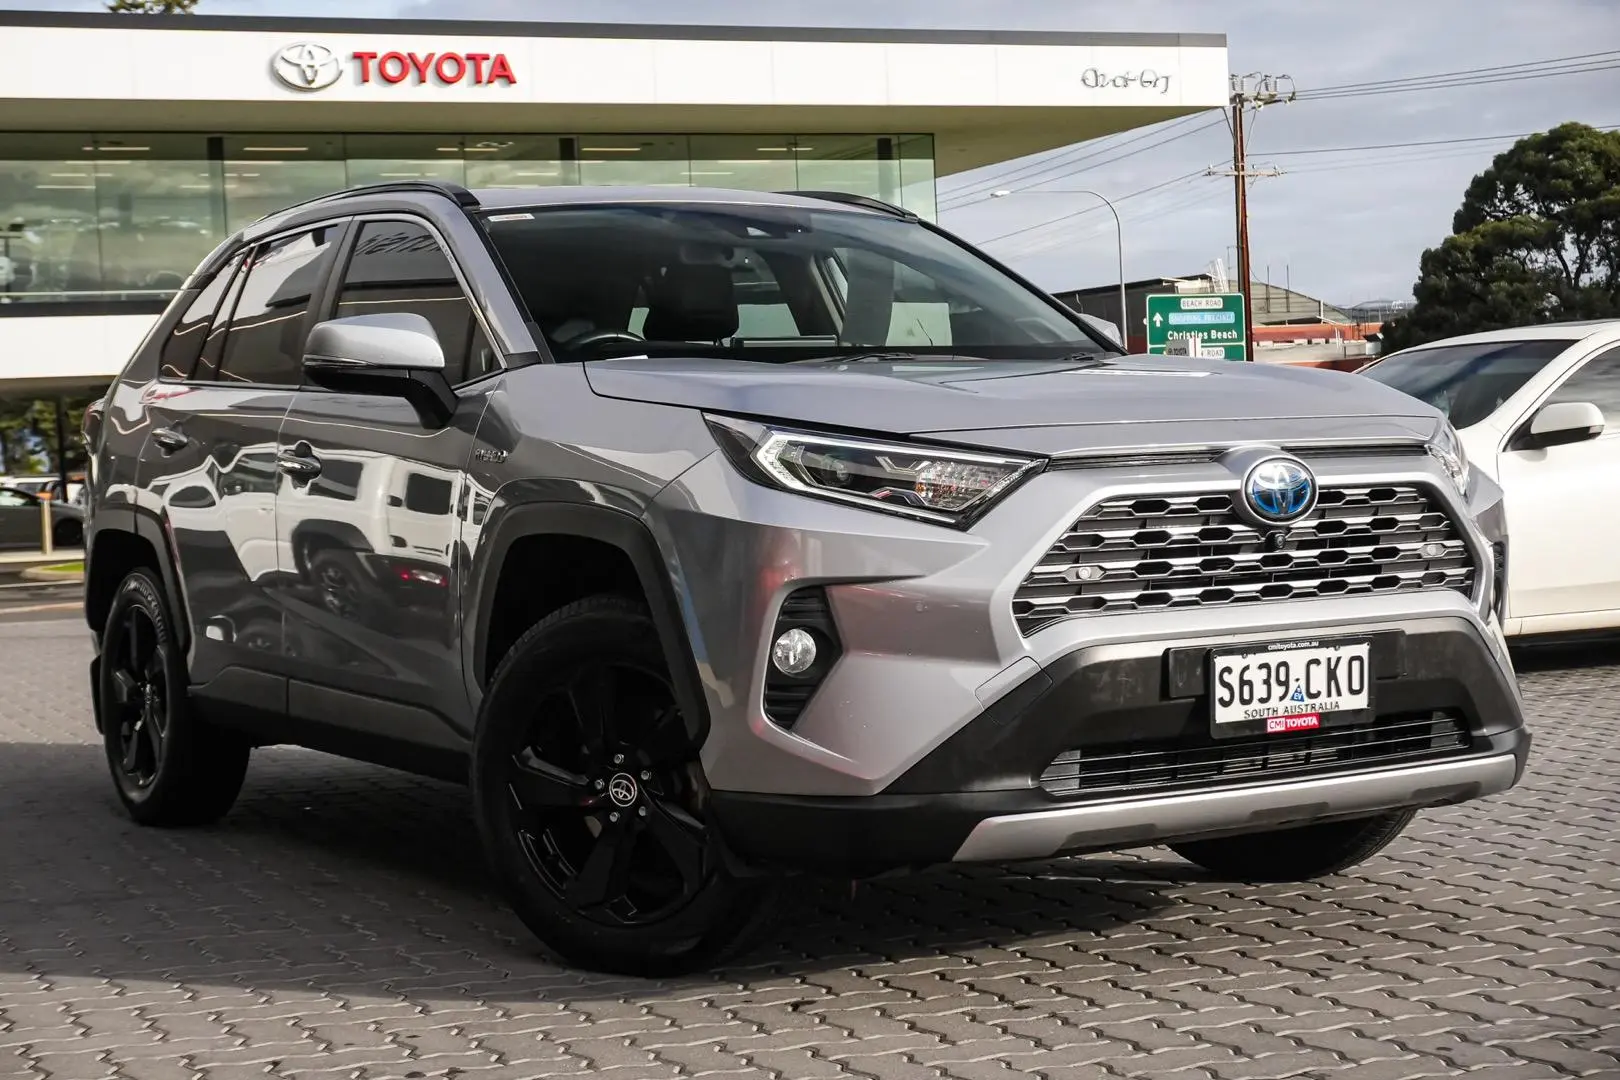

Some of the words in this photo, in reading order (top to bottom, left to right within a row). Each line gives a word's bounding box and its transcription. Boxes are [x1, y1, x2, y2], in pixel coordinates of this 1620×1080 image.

[353, 51, 517, 85] TOYOTA
[1206, 299, 1221, 307] ROAD
[1167, 330, 1208, 340] Christies
[1210, 329, 1237, 339] Beach
[1207, 349, 1223, 357] ROAD
[1267, 640, 1319, 651] cmitoyota.com.au
[1243, 706, 1279, 720] SOUTH
[1283, 701, 1340, 715] AUSTRALIA
[1286, 715, 1318, 728] TOYOTA
